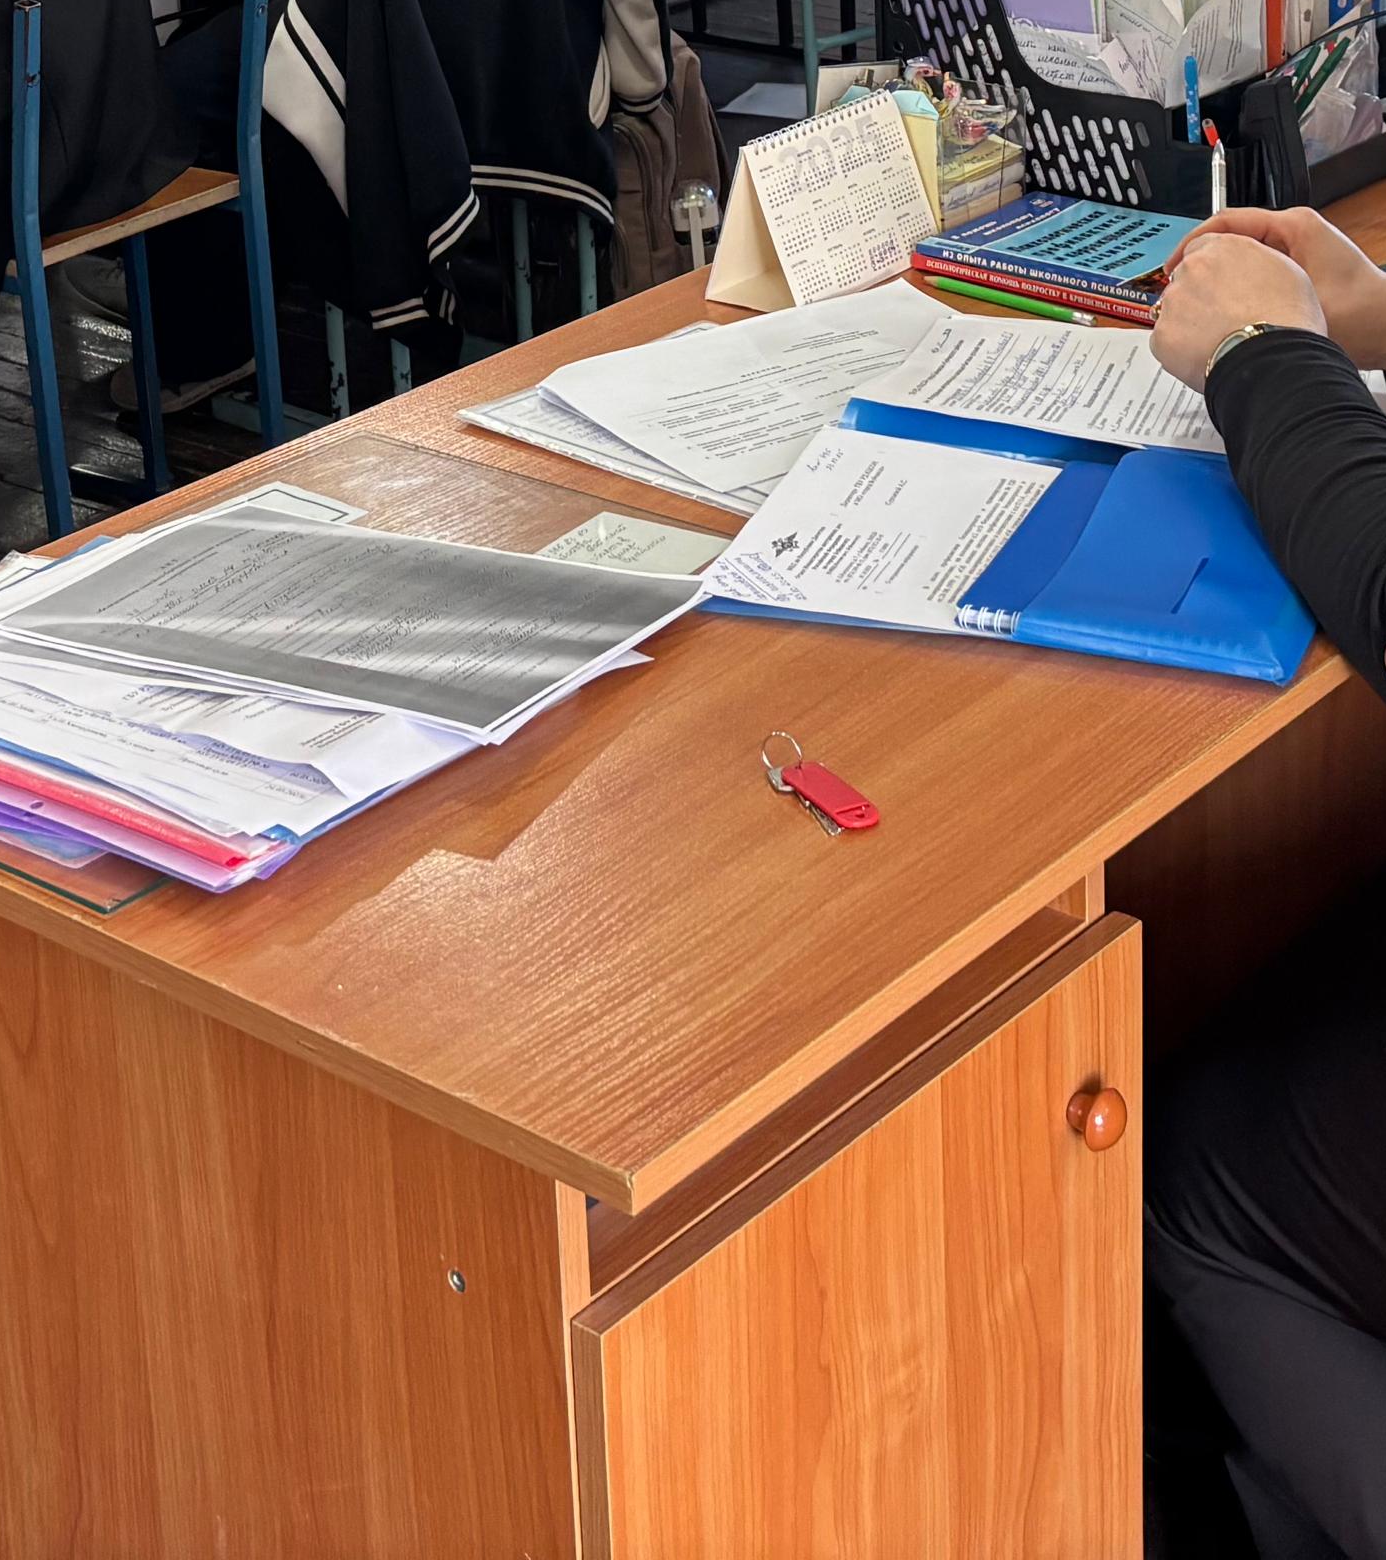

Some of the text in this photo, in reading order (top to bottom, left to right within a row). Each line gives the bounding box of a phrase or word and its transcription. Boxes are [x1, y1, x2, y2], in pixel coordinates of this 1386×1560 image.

[942, 249, 1148, 302] ИЗ ОПЫТА РАБОТЫ ШКОЛЬНОГО ПСИХОЛОГА
